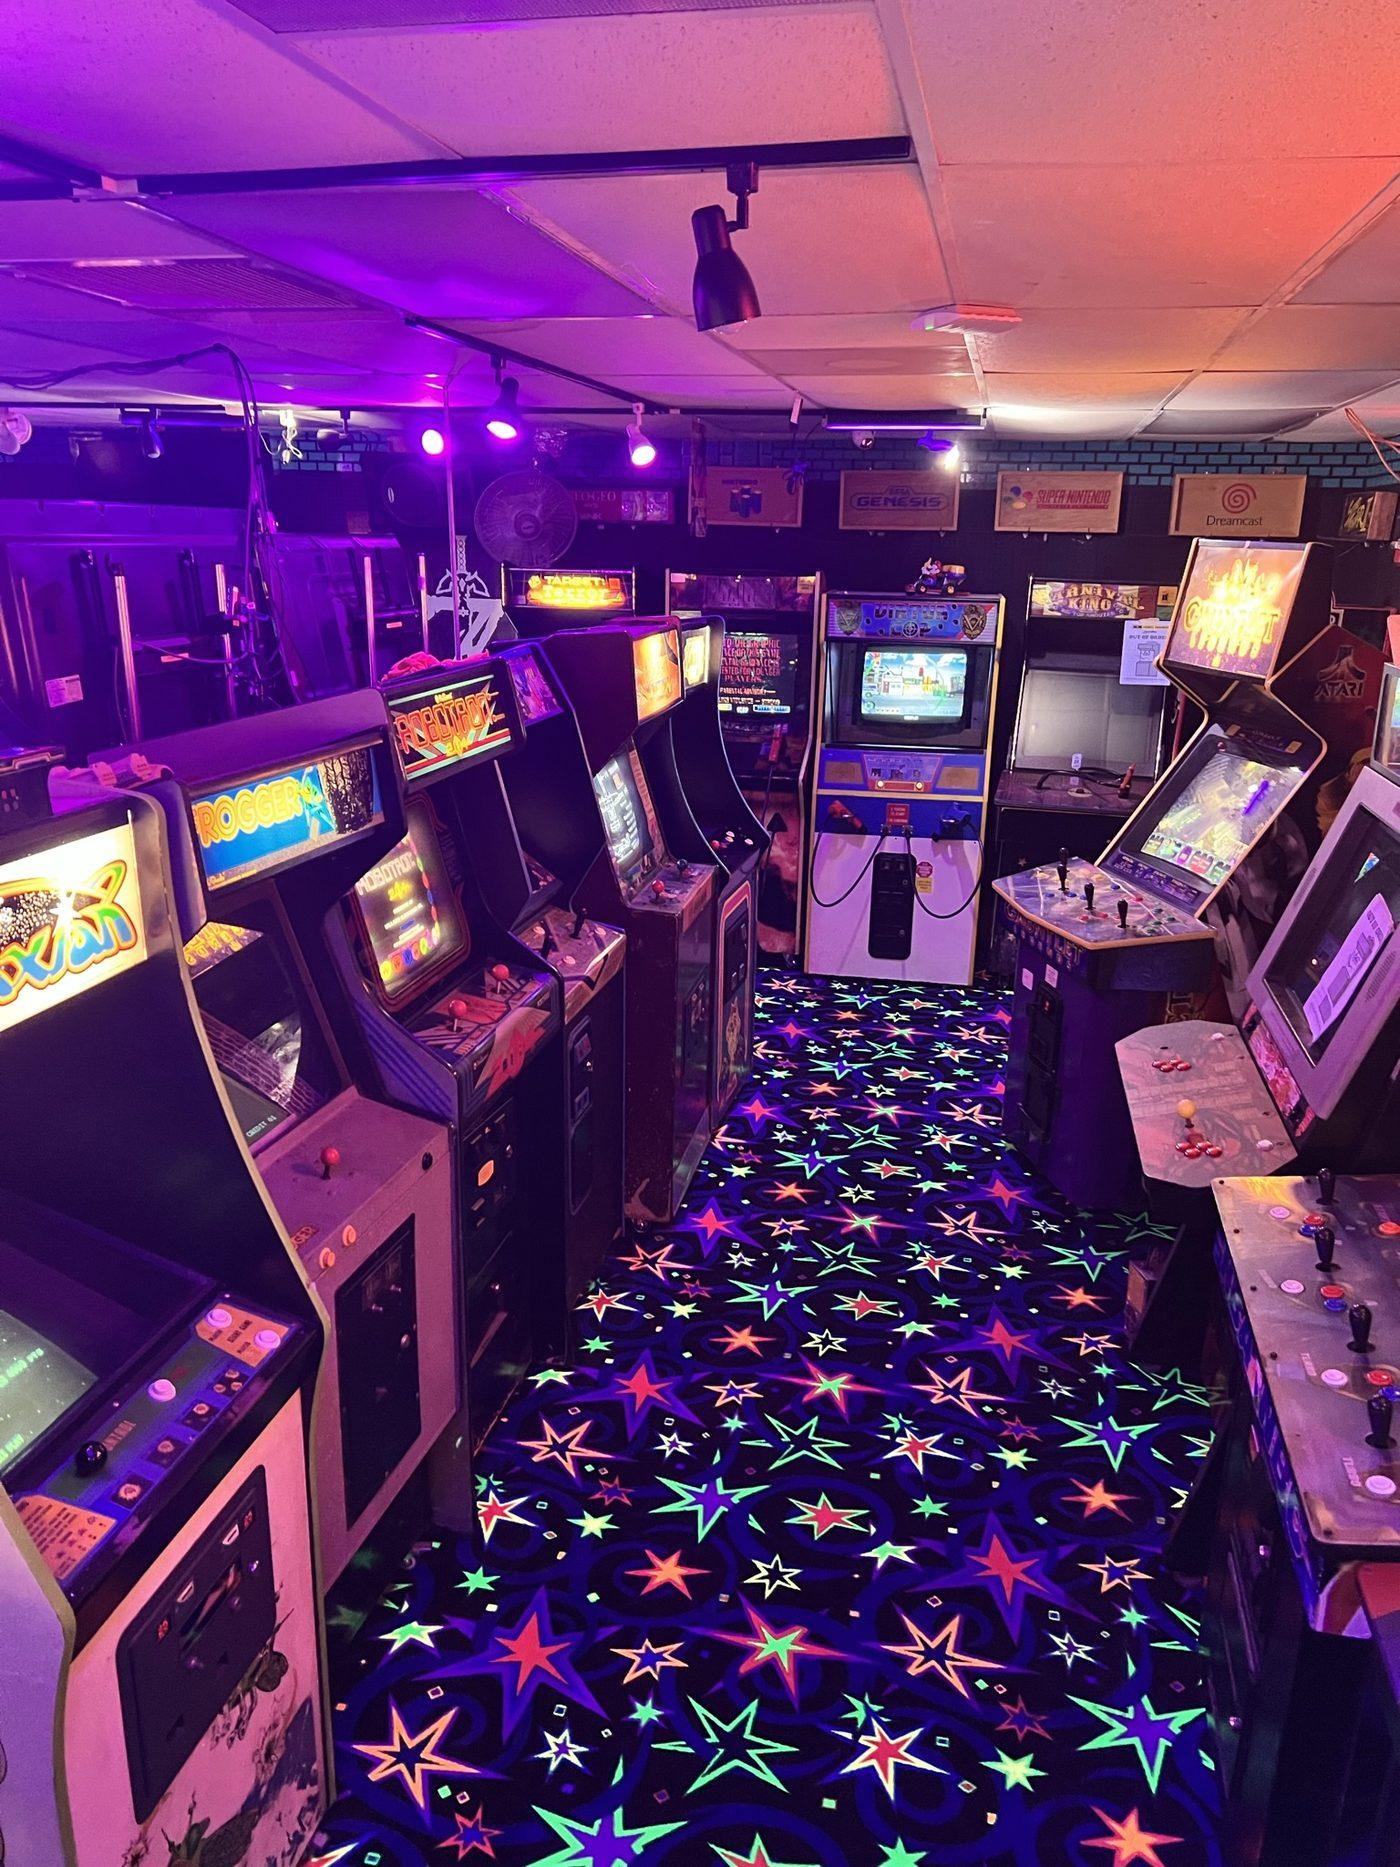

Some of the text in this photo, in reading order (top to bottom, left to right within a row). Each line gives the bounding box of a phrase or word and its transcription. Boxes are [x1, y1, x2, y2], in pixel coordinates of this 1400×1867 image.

[857, 496, 941, 508] GENESIS
[1037, 489, 1111, 504] SUPER NINTENDO
[1206, 514, 1264, 526] Dreamcast
[1315, 682, 1364, 697] ATARI
[394, 693, 493, 754] ROBOTRON
[193, 776, 303, 848] ROGGER
[246, 1121, 267, 1137] CREDIT
